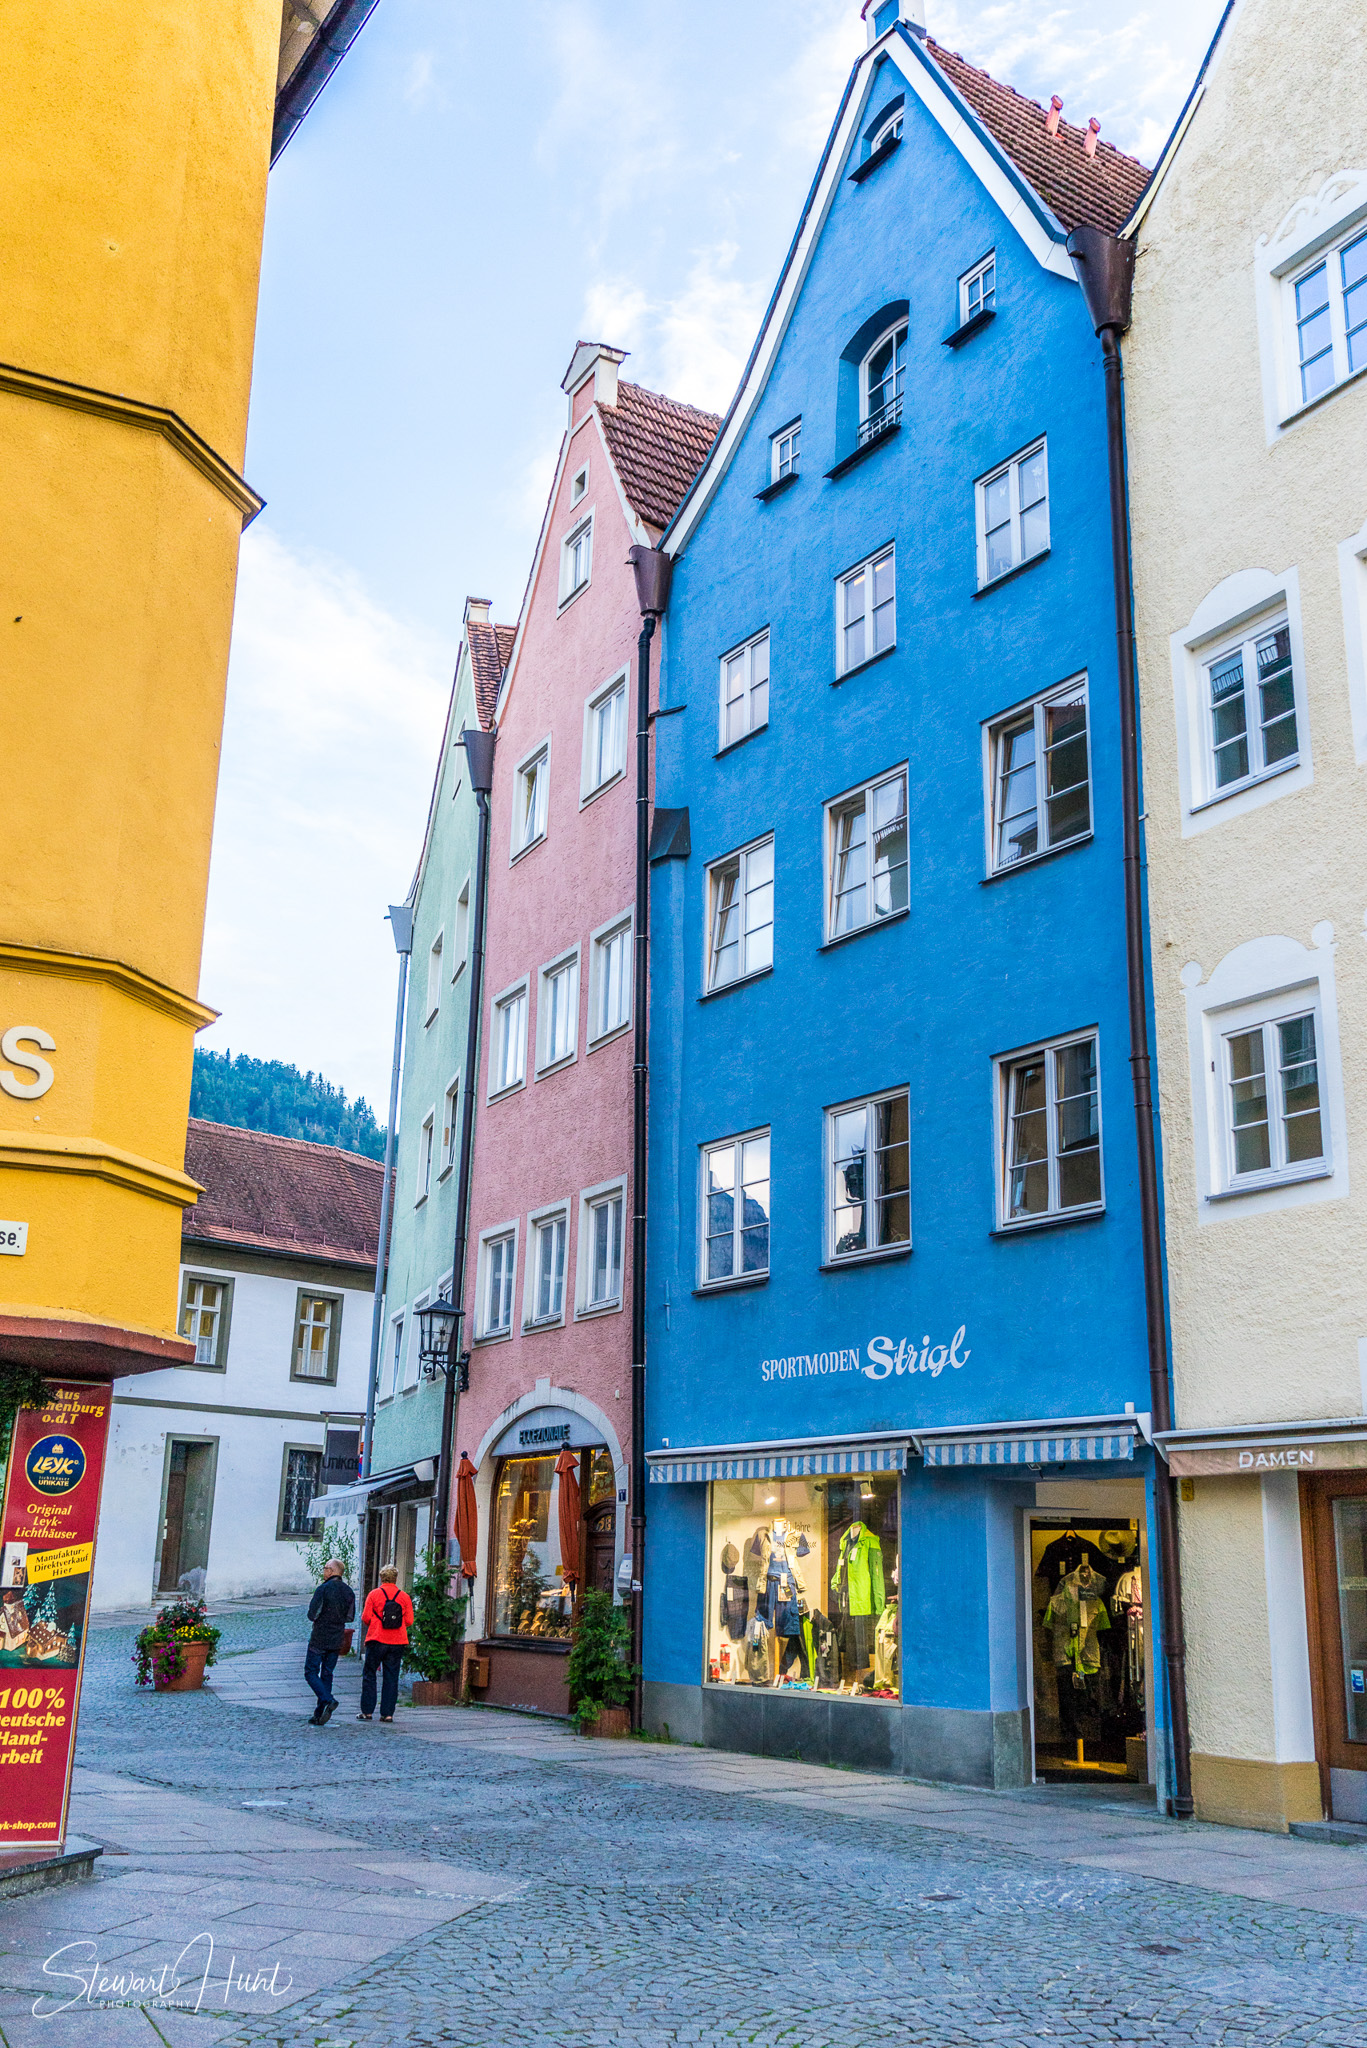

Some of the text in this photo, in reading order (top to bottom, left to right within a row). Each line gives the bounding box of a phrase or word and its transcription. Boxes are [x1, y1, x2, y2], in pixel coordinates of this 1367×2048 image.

[0, 1025, 56, 1099] S
[762, 1324, 971, 1381] SPORTMODEN Strigl
[56, 1388, 80, 1400] Aus
[1238, 1450, 1314, 1469] DAMEN
[26, 1503, 73, 1517] Original
[33, 1516, 62, 1529] Leyk-
[15, 1527, 78, 1539] Lichthäuser
[34, 1554, 89, 1572] Direktverkauf
[35, 1548, 85, 1563] Manufaktur-
[52, 1567, 73, 1577] Hier
[0, 1687, 66, 1709] 100%
[0, 1712, 66, 1727] eutsche
